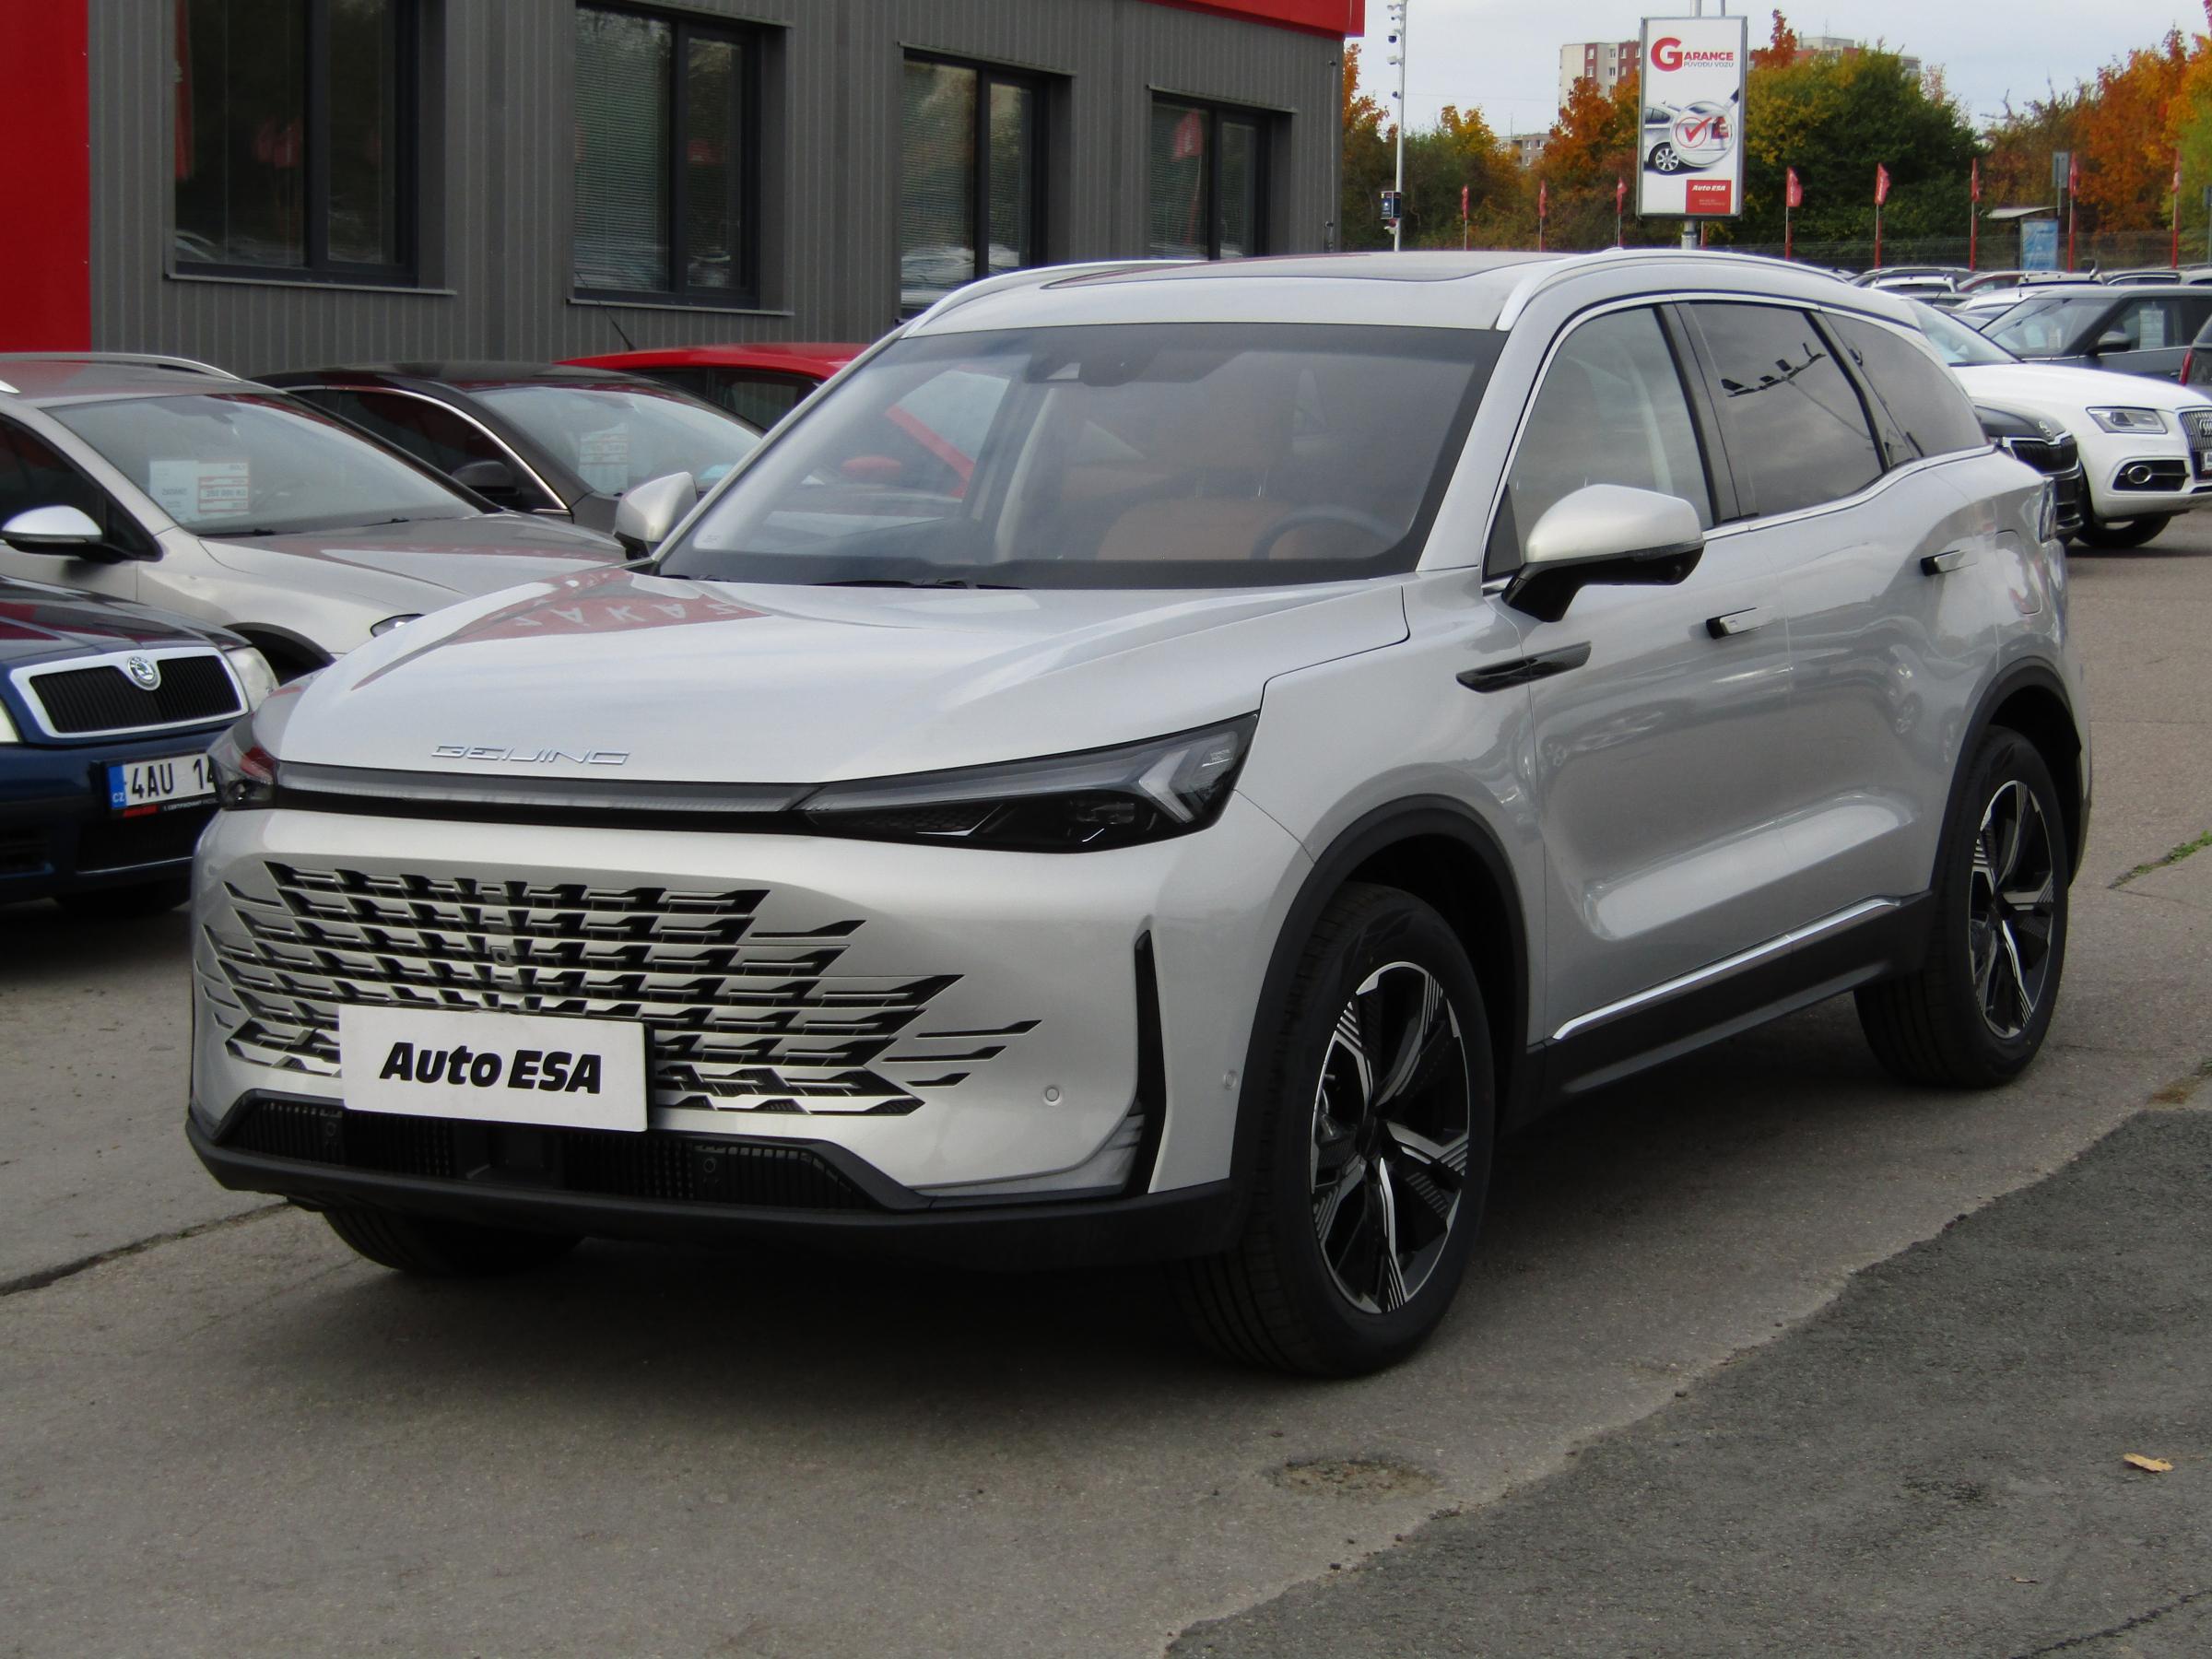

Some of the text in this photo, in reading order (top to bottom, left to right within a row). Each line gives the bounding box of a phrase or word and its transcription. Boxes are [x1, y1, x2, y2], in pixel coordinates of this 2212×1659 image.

[1651, 37, 1734, 72] GARANCE
[431, 745, 630, 765] BEIJING
[112, 793, 125, 803] CZ
[132, 762, 174, 799] 4AU
[379, 1041, 601, 1095] Auto ESA
